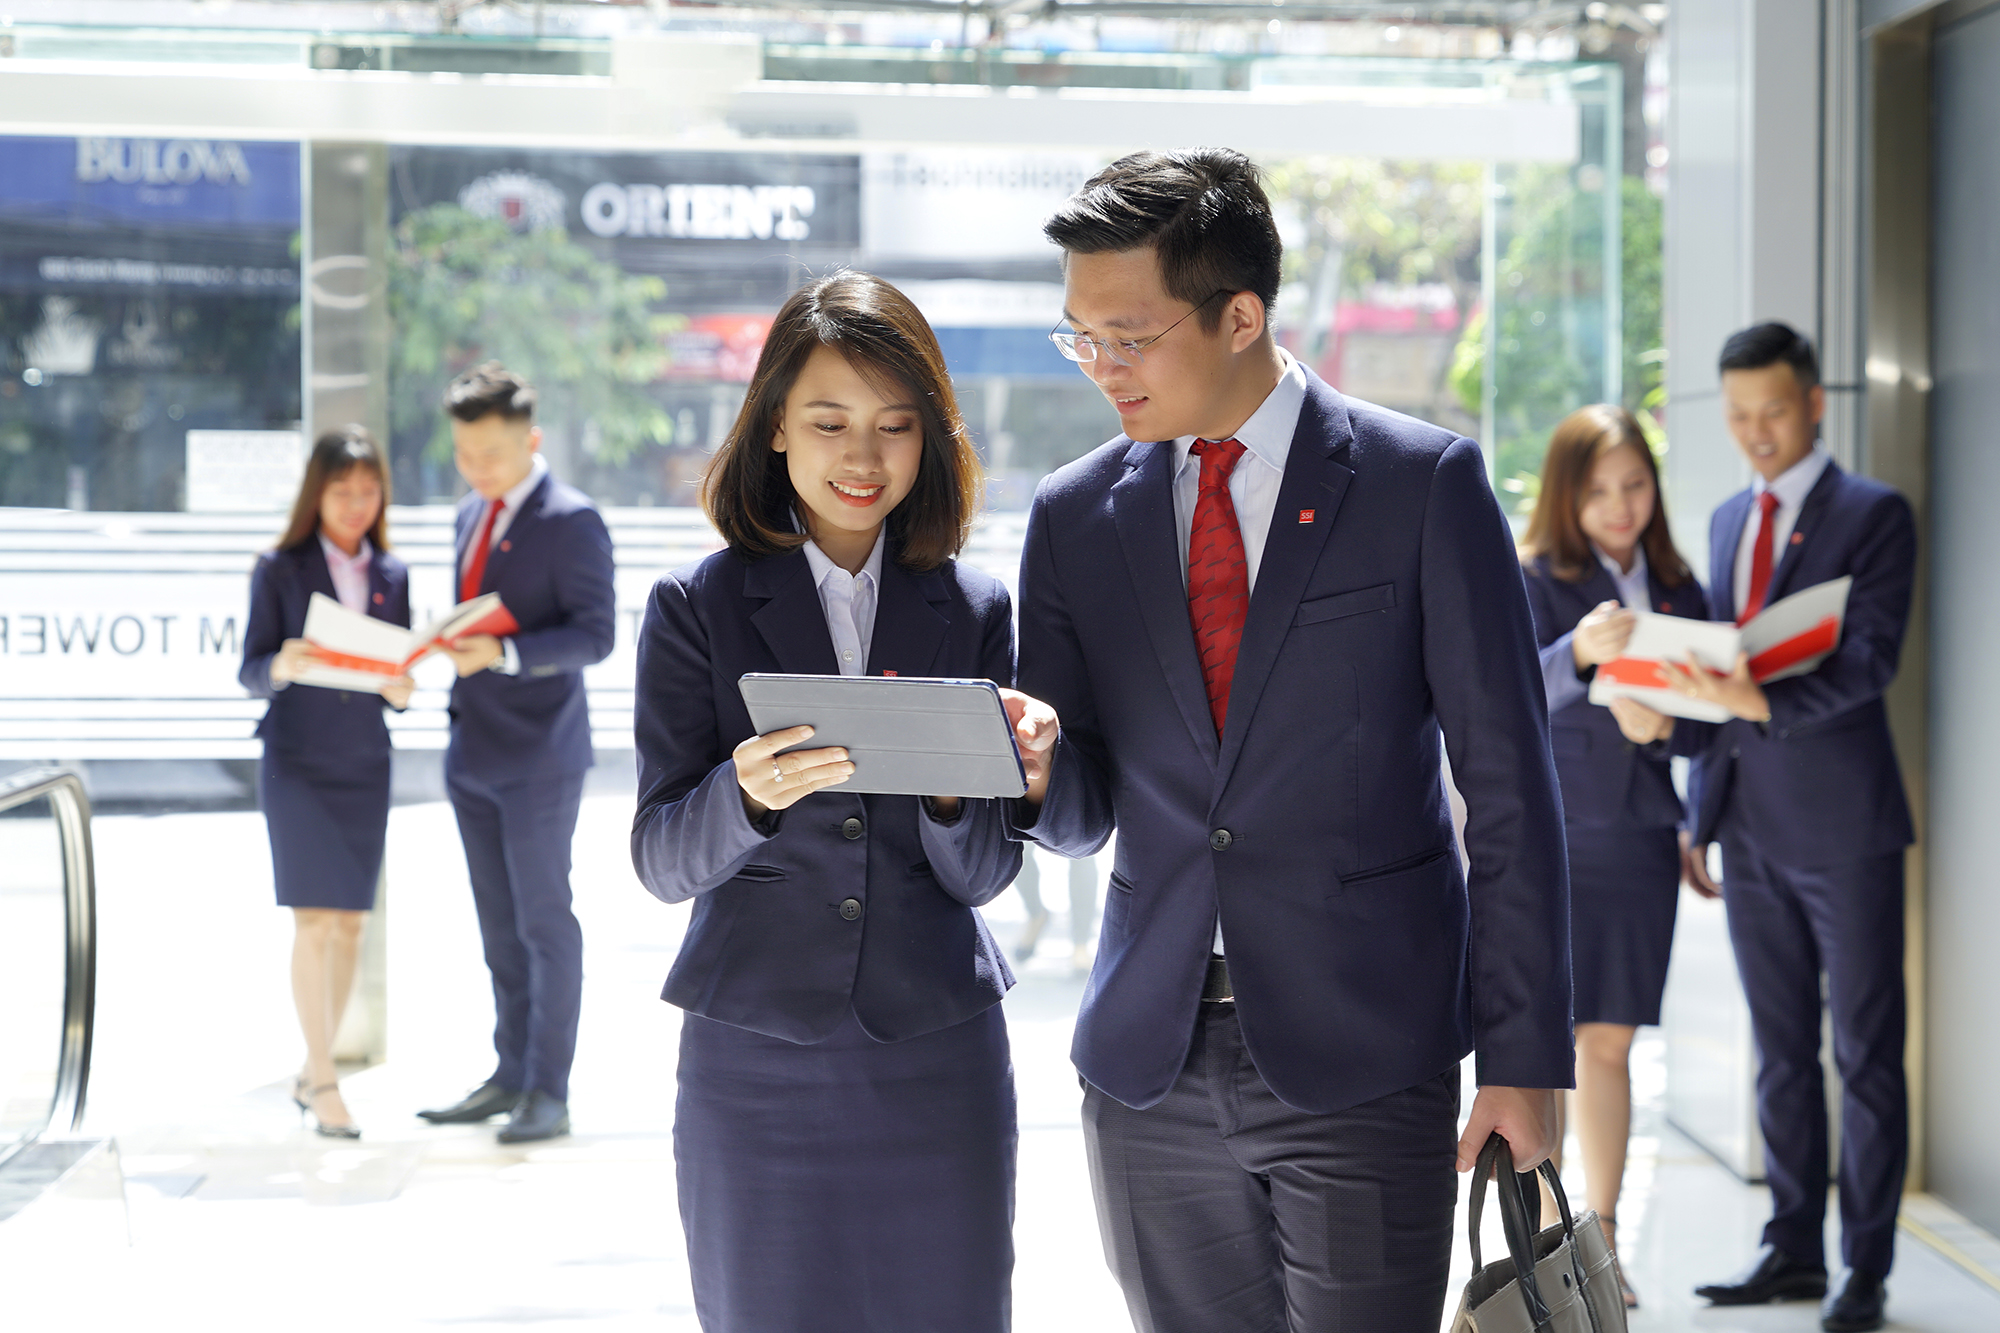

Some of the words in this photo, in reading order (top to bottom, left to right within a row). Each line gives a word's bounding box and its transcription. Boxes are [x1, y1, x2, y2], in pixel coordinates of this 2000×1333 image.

[77, 137, 250, 186] BULOVA
[580, 181, 816, 240] ORIENT
[1301, 512, 1313, 520] SSI
